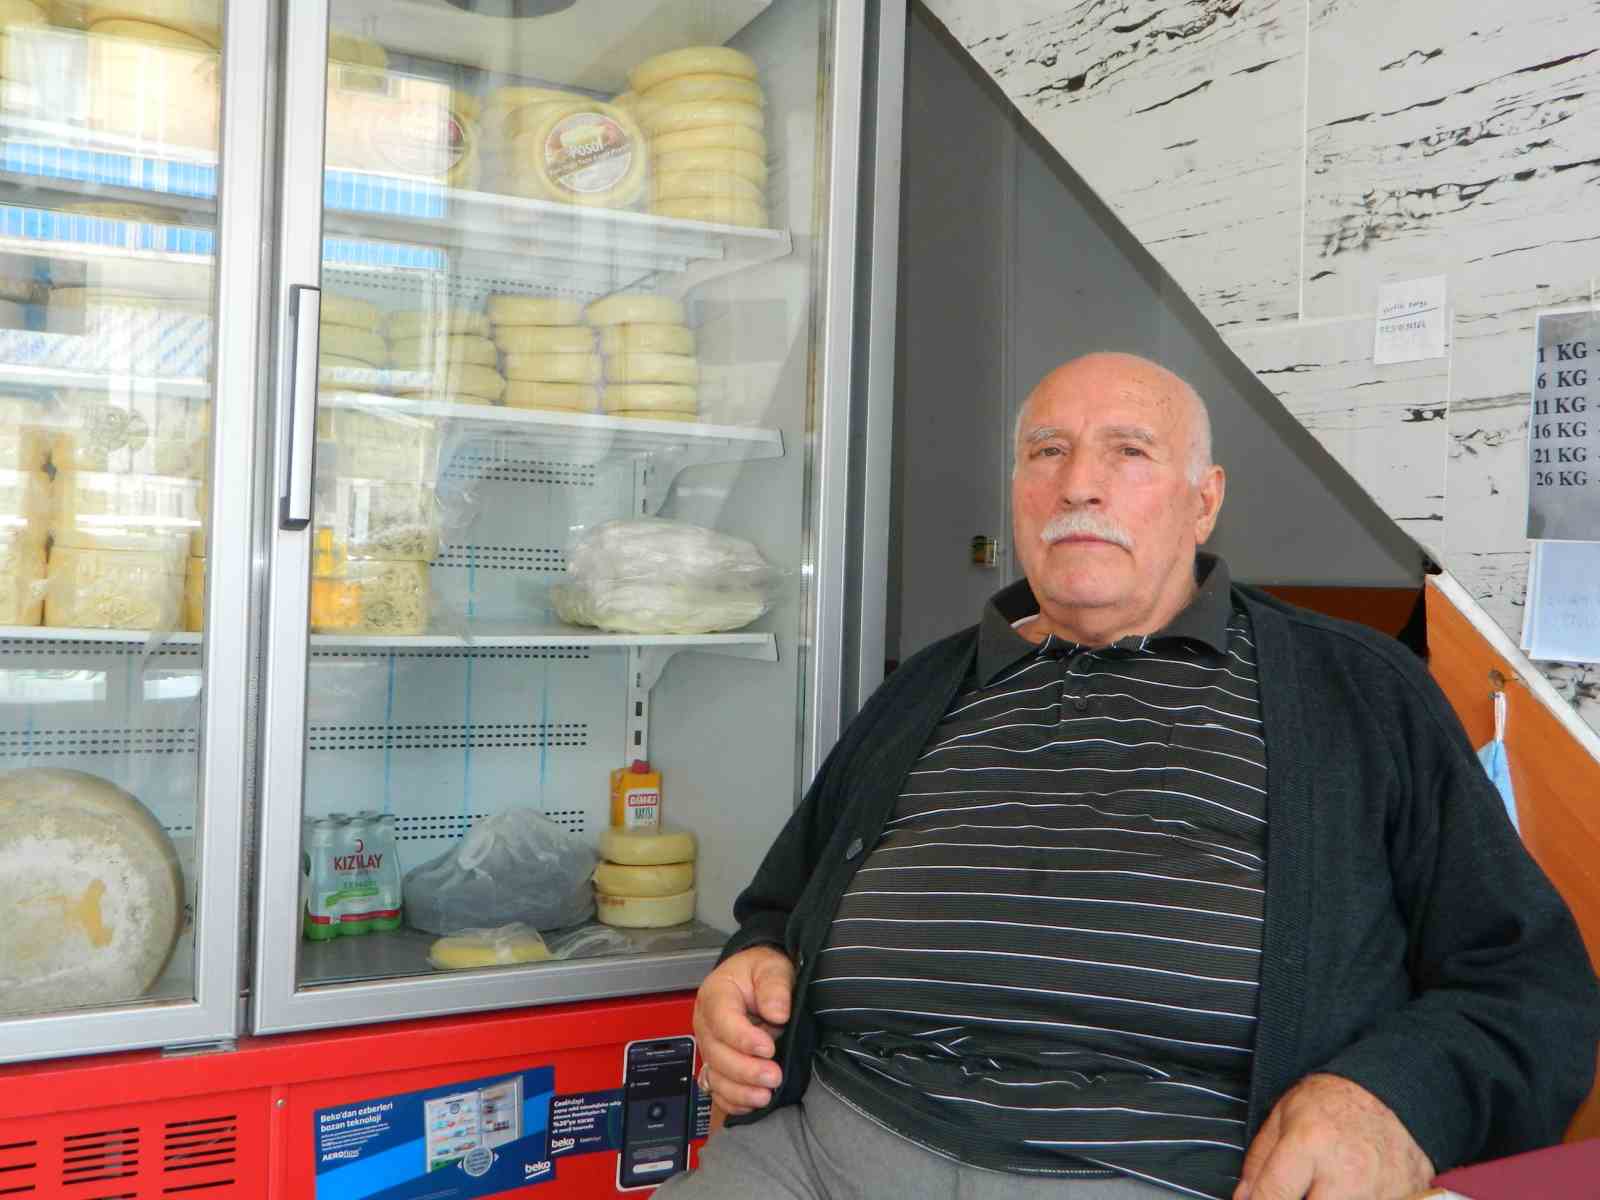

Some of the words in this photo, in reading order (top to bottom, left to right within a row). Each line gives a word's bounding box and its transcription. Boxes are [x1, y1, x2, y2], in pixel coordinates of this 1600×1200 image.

[1538, 347, 1545, 363] 1
[1556, 342, 1588, 361] KG
[1537, 372, 1546, 389] 6
[1557, 369, 1588, 387] KG
[1535, 399, 1548, 415] 11
[1554, 396, 1587, 413] KG
[1534, 424, 1551, 439] 16
[1556, 421, 1587, 438] KG
[1534, 448, 1551, 463] 21
[1557, 447, 1587, 462] KG
[1536, 471, 1553, 486] 26
[1558, 471, 1588, 486] KG
[334, 854, 383, 871] KIZILAY
[320, 1109, 357, 1123] Beko'dan
[358, 1101, 393, 1115] ezberleri
[320, 1122, 346, 1133] bozan
[346, 1113, 382, 1128] teknoloji
[551, 1137, 576, 1149] beko
[525, 1160, 552, 1174] beko
